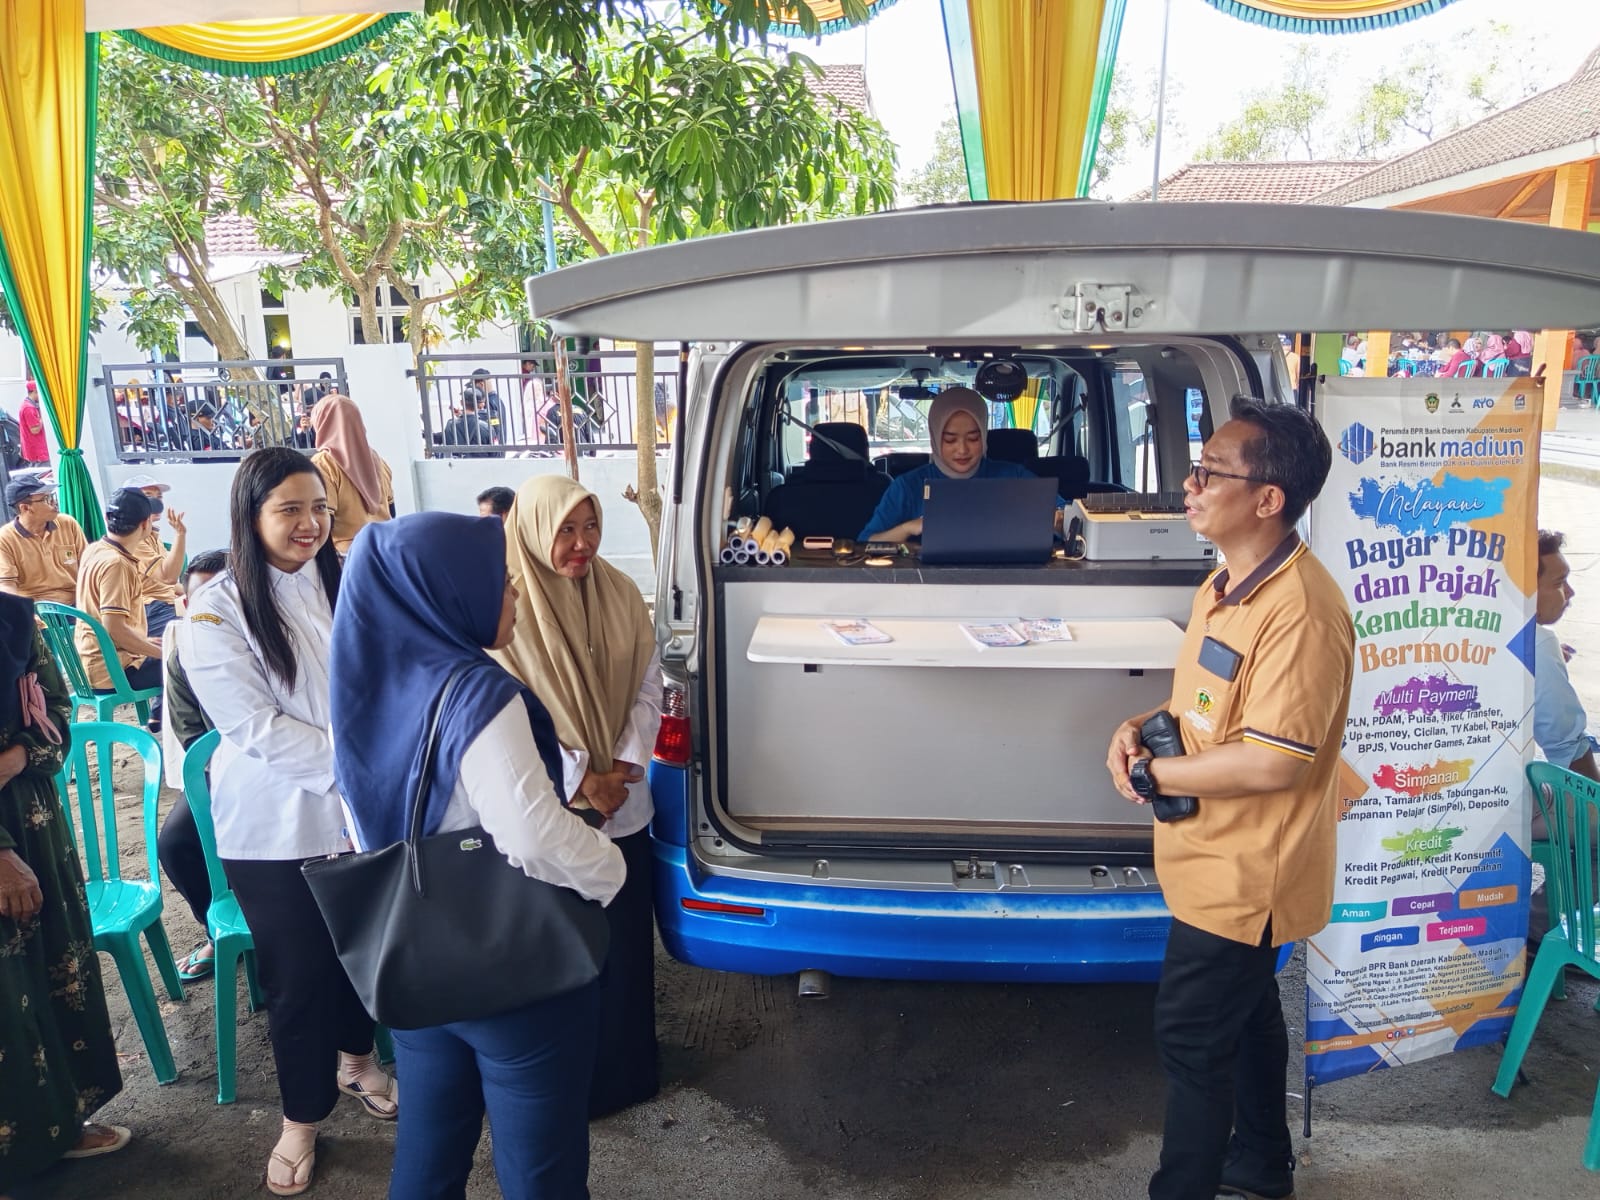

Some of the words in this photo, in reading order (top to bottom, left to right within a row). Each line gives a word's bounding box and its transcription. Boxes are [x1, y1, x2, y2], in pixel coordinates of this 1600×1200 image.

[1472, 397, 1495, 409] AYO
[1380, 427, 1409, 435] Perumda
[1410, 427, 1424, 435] BPR
[1425, 427, 1441, 435] Bank
[1380, 436, 1437, 459] bank
[1440, 435, 1524, 458] madiun
[1375, 485, 1485, 530] Melayani
[1345, 535, 1439, 570] Bayar
[1447, 527, 1506, 563] PBB
[1354, 573, 1410, 604] dan
[1419, 564, 1501, 601] Pajak
[1359, 638, 1497, 673] Bermotor
[1380, 690, 1413, 705] Multi
[1418, 688, 1477, 706] Payment
[1346, 716, 1369, 728] PLN,
[1372, 714, 1405, 726] PDAM,
[1408, 712, 1439, 724] Pulsa,
[1467, 707, 1503, 720] Transfer,
[1349, 731, 1363, 742] Up
[1365, 729, 1411, 740] e-money,
[1414, 726, 1448, 738] Cicilan,
[1451, 724, 1462, 734] TV
[1463, 721, 1488, 733] Kabel,
[1358, 742, 1387, 754] BPJS,
[1390, 741, 1432, 751] Voucher
[1434, 738, 1465, 749] Games,
[1467, 734, 1491, 746] Zakat
[1394, 770, 1460, 790] Simpanan
[1343, 797, 1382, 808] Tamara,
[1384, 794, 1421, 806] Tamara
[1446, 785, 1509, 800] Tabungan-Ku,
[1341, 810, 1393, 822] Simpanan
[1396, 806, 1425, 820] Pelajar
[1468, 797, 1510, 811] Deposito
[1405, 836, 1442, 852] Kredit
[1344, 861, 1378, 873] Kredit
[1380, 857, 1423, 872] Produktif,
[1424, 853, 1453, 865] Kredit
[1344, 874, 1378, 886] Kredit
[1380, 870, 1418, 885] Pegawai,
[1421, 866, 1448, 879] Kredit
[1450, 862, 1503, 875] Perumahan
[1341, 908, 1371, 918] Aman
[1410, 900, 1435, 911] Cepat
[1477, 892, 1504, 902] Mudah
[1373, 932, 1403, 944] Ringan
[1438, 923, 1474, 936] Terjamin
[1368, 962, 1387, 972] BPR
[1388, 960, 1409, 971] Bank
[1438, 952, 1477, 964] Kabupaten
[1478, 947, 1502, 958] Madiun
